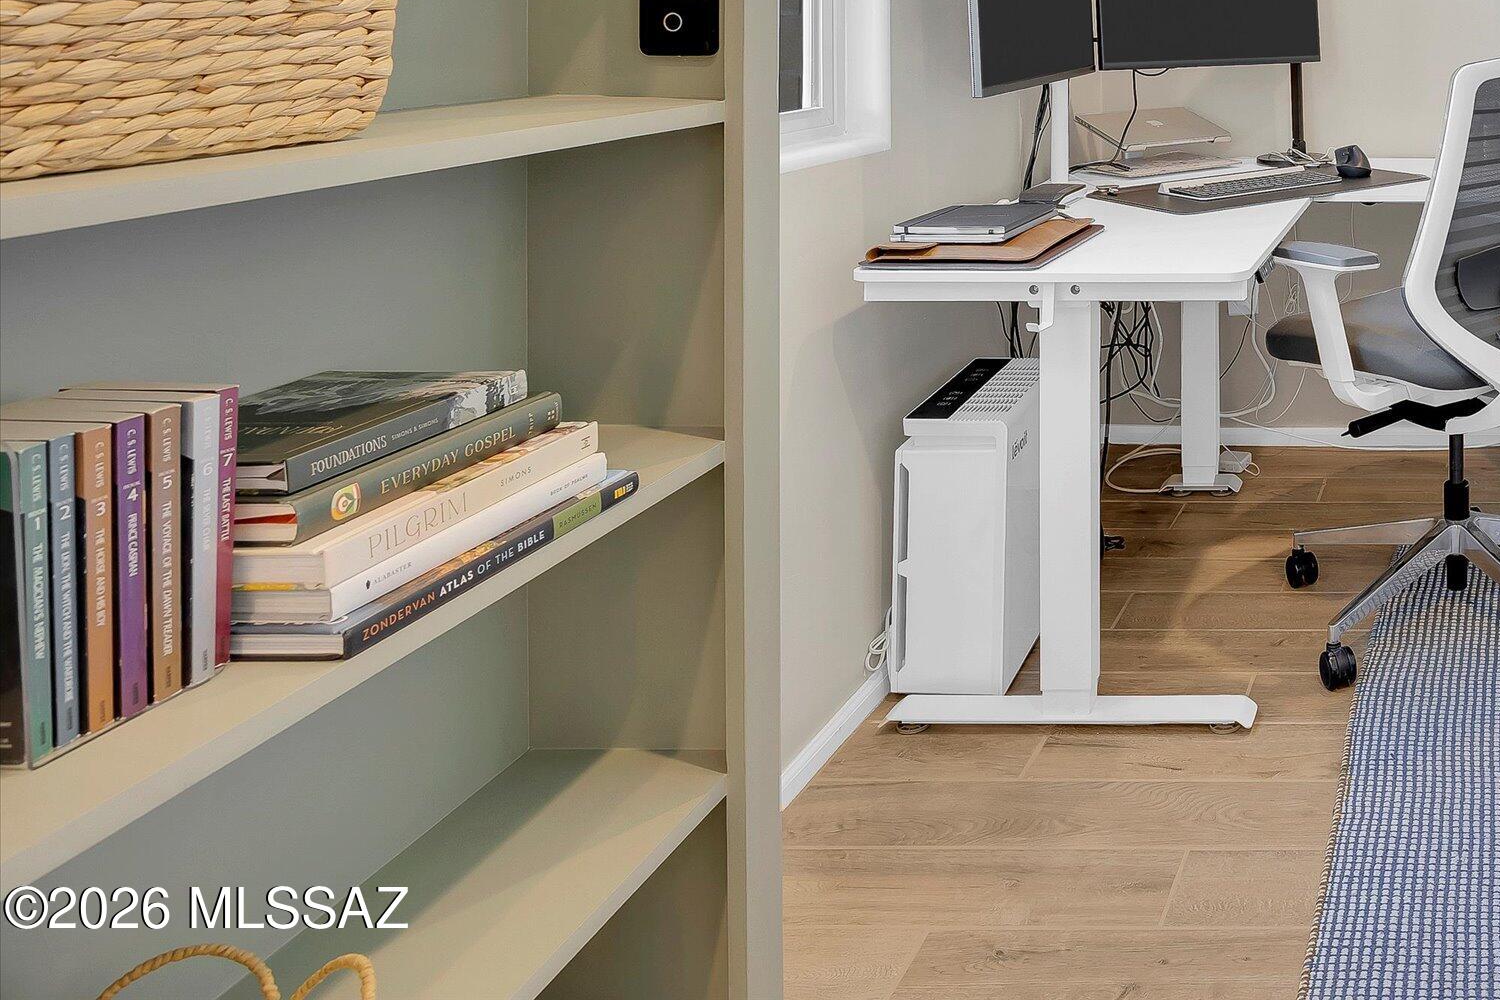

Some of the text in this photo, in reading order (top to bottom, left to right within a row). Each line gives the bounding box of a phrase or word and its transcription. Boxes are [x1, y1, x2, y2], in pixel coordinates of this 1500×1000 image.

[224, 416, 233, 441] LEWIS
[391, 418, 439, 441] SIMONS SIMONS
[127, 448, 137, 475] LEWIS
[162, 437, 172, 462] LEWIS
[223, 452, 235, 467] 7
[310, 435, 387, 477] FOUNDATIONS
[380, 426, 516, 495] EVERYDAY GOSPEL
[59, 462, 69, 491] LEWIS
[95, 462, 105, 489] LEWIS
[202, 462, 213, 476] 6
[500, 466, 533, 487] SIMONS
[31, 474, 41, 502] LEWIS
[162, 474, 173, 490] 5
[127, 488, 139, 502] 4
[59, 504, 71, 520] 2
[96, 501, 106, 517] 3
[220, 477, 232, 542] THE LAST BATTLE
[35, 517, 42, 531] 1
[96, 527, 106, 545] THE
[368, 491, 467, 559] PILGRIM
[32, 543, 43, 563] THE
[60, 532, 71, 549] THE
[128, 512, 139, 578] PRINCE CASPIAN
[96, 547, 106, 575] HORSE
[61, 574, 72, 592] THE
[96, 576, 106, 595] AND
[161, 500, 174, 657] THE VOYAGE OF THE DAWN TREADER
[362, 530, 546, 641] ZONDERVAN ATLAS OF THE BIBLE
[62, 593, 73, 621] WITCH
